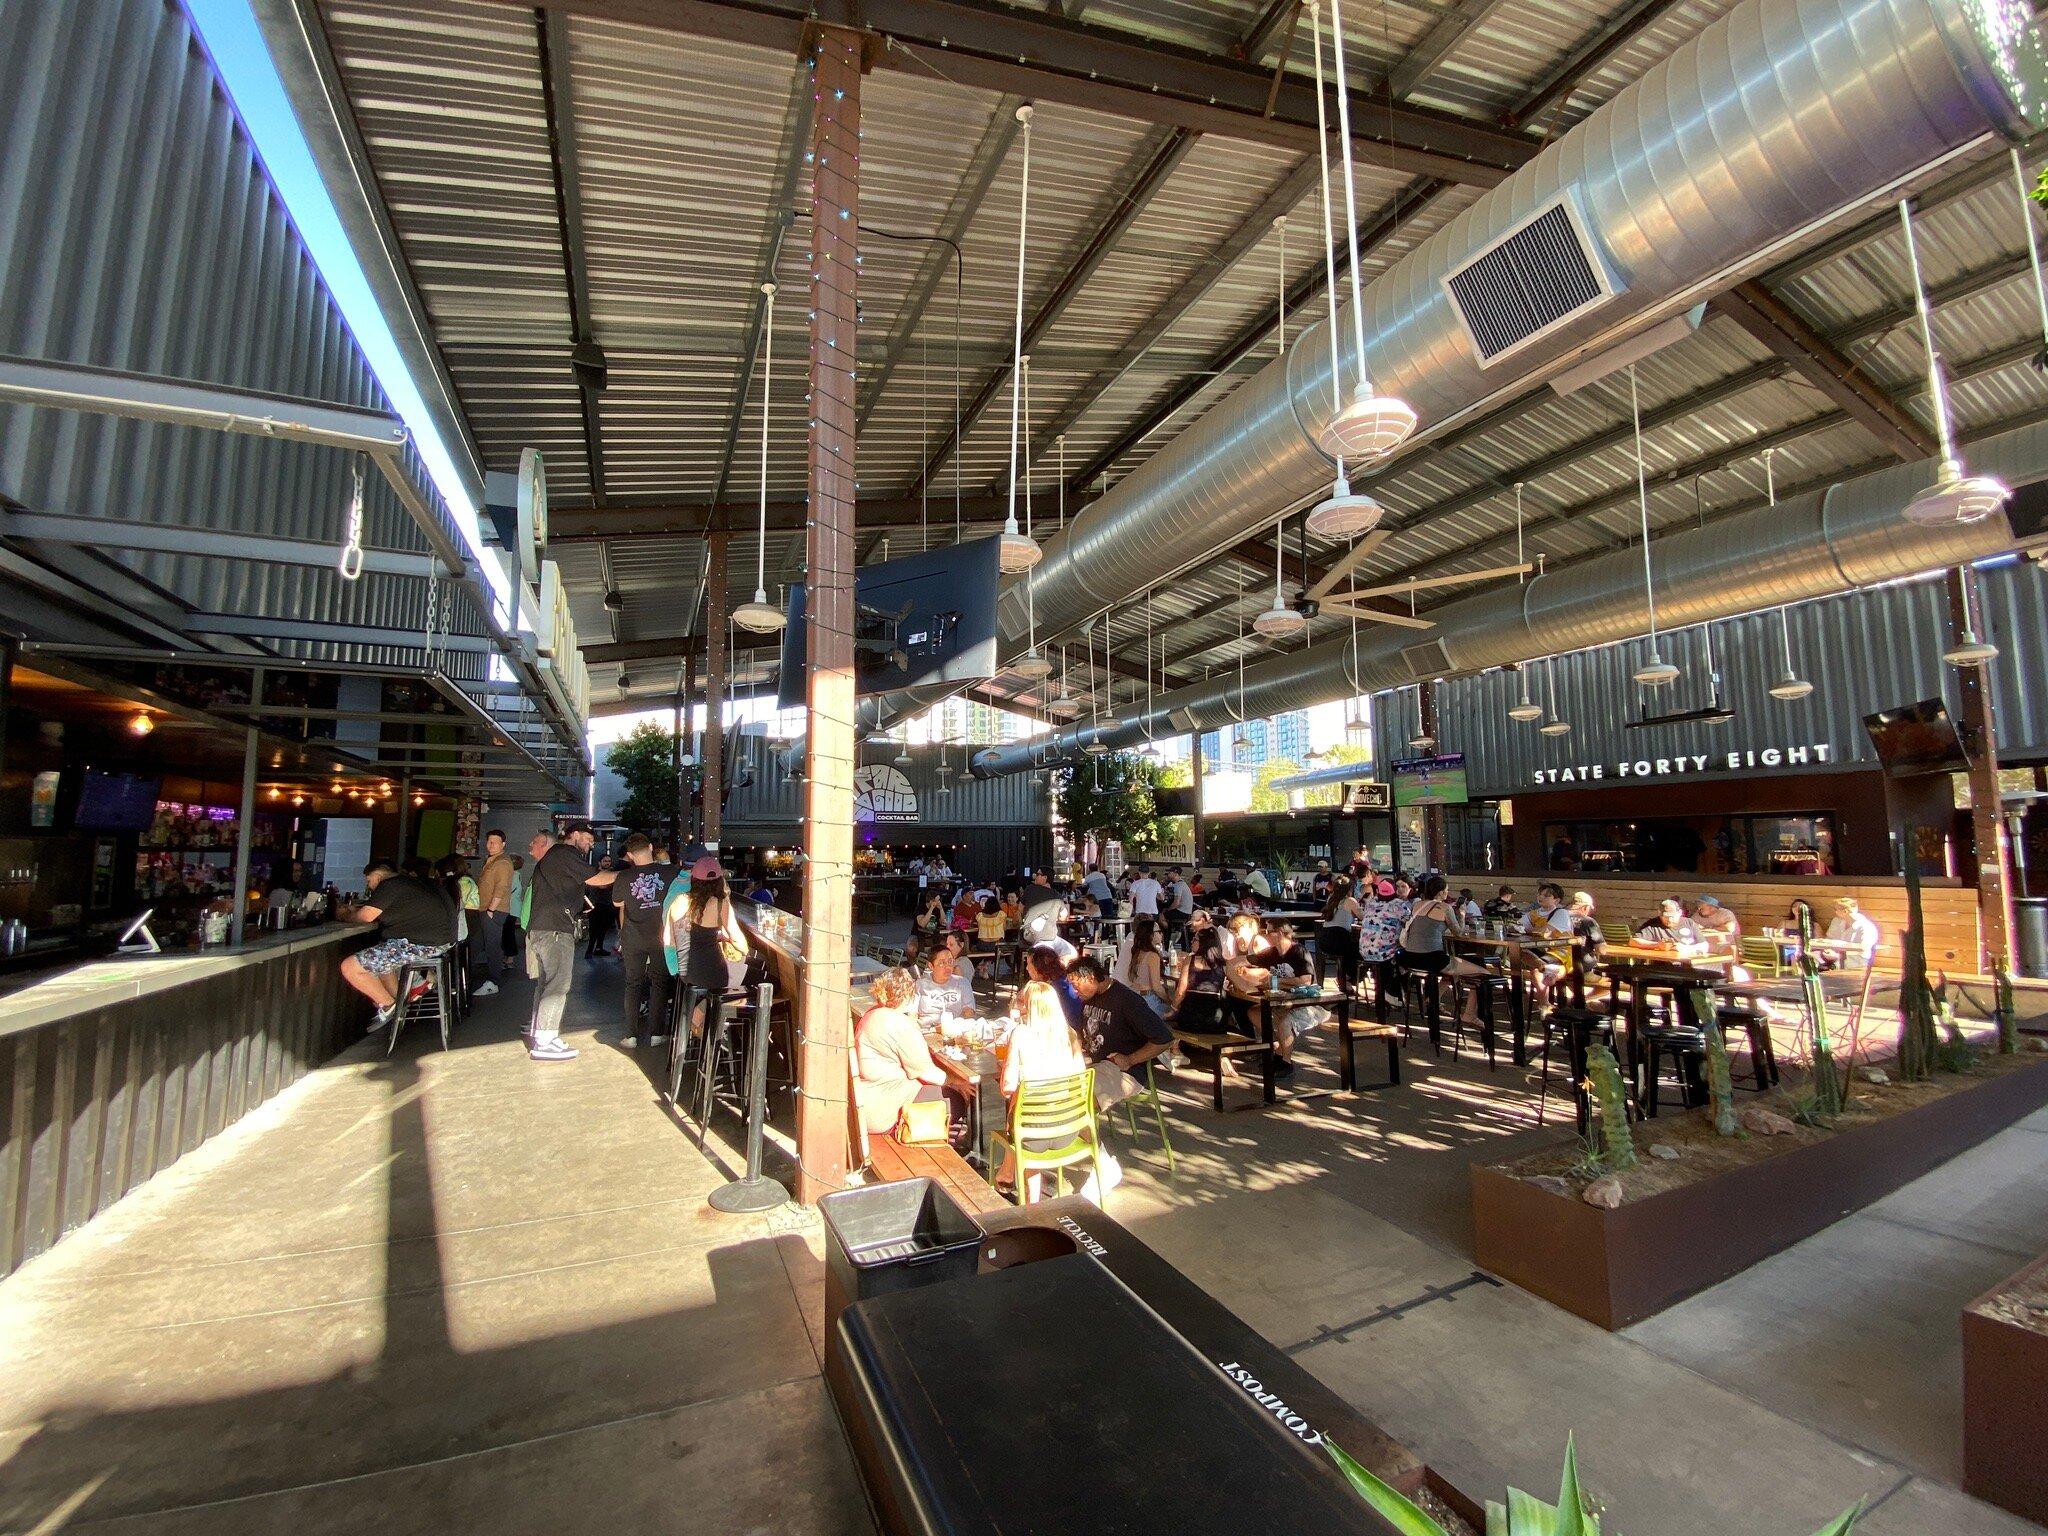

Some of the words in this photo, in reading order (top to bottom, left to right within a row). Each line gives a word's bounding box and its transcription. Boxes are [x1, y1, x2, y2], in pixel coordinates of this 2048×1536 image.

[1534, 765, 1603, 784] STATE
[1619, 754, 1708, 777] FORTY
[1727, 744, 1829, 768] EIGHT
[1350, 792, 1382, 804] PROVECHO
[1056, 1216, 1108, 1256] RECYCLE
[1218, 1361, 1322, 1443] COMPOST
